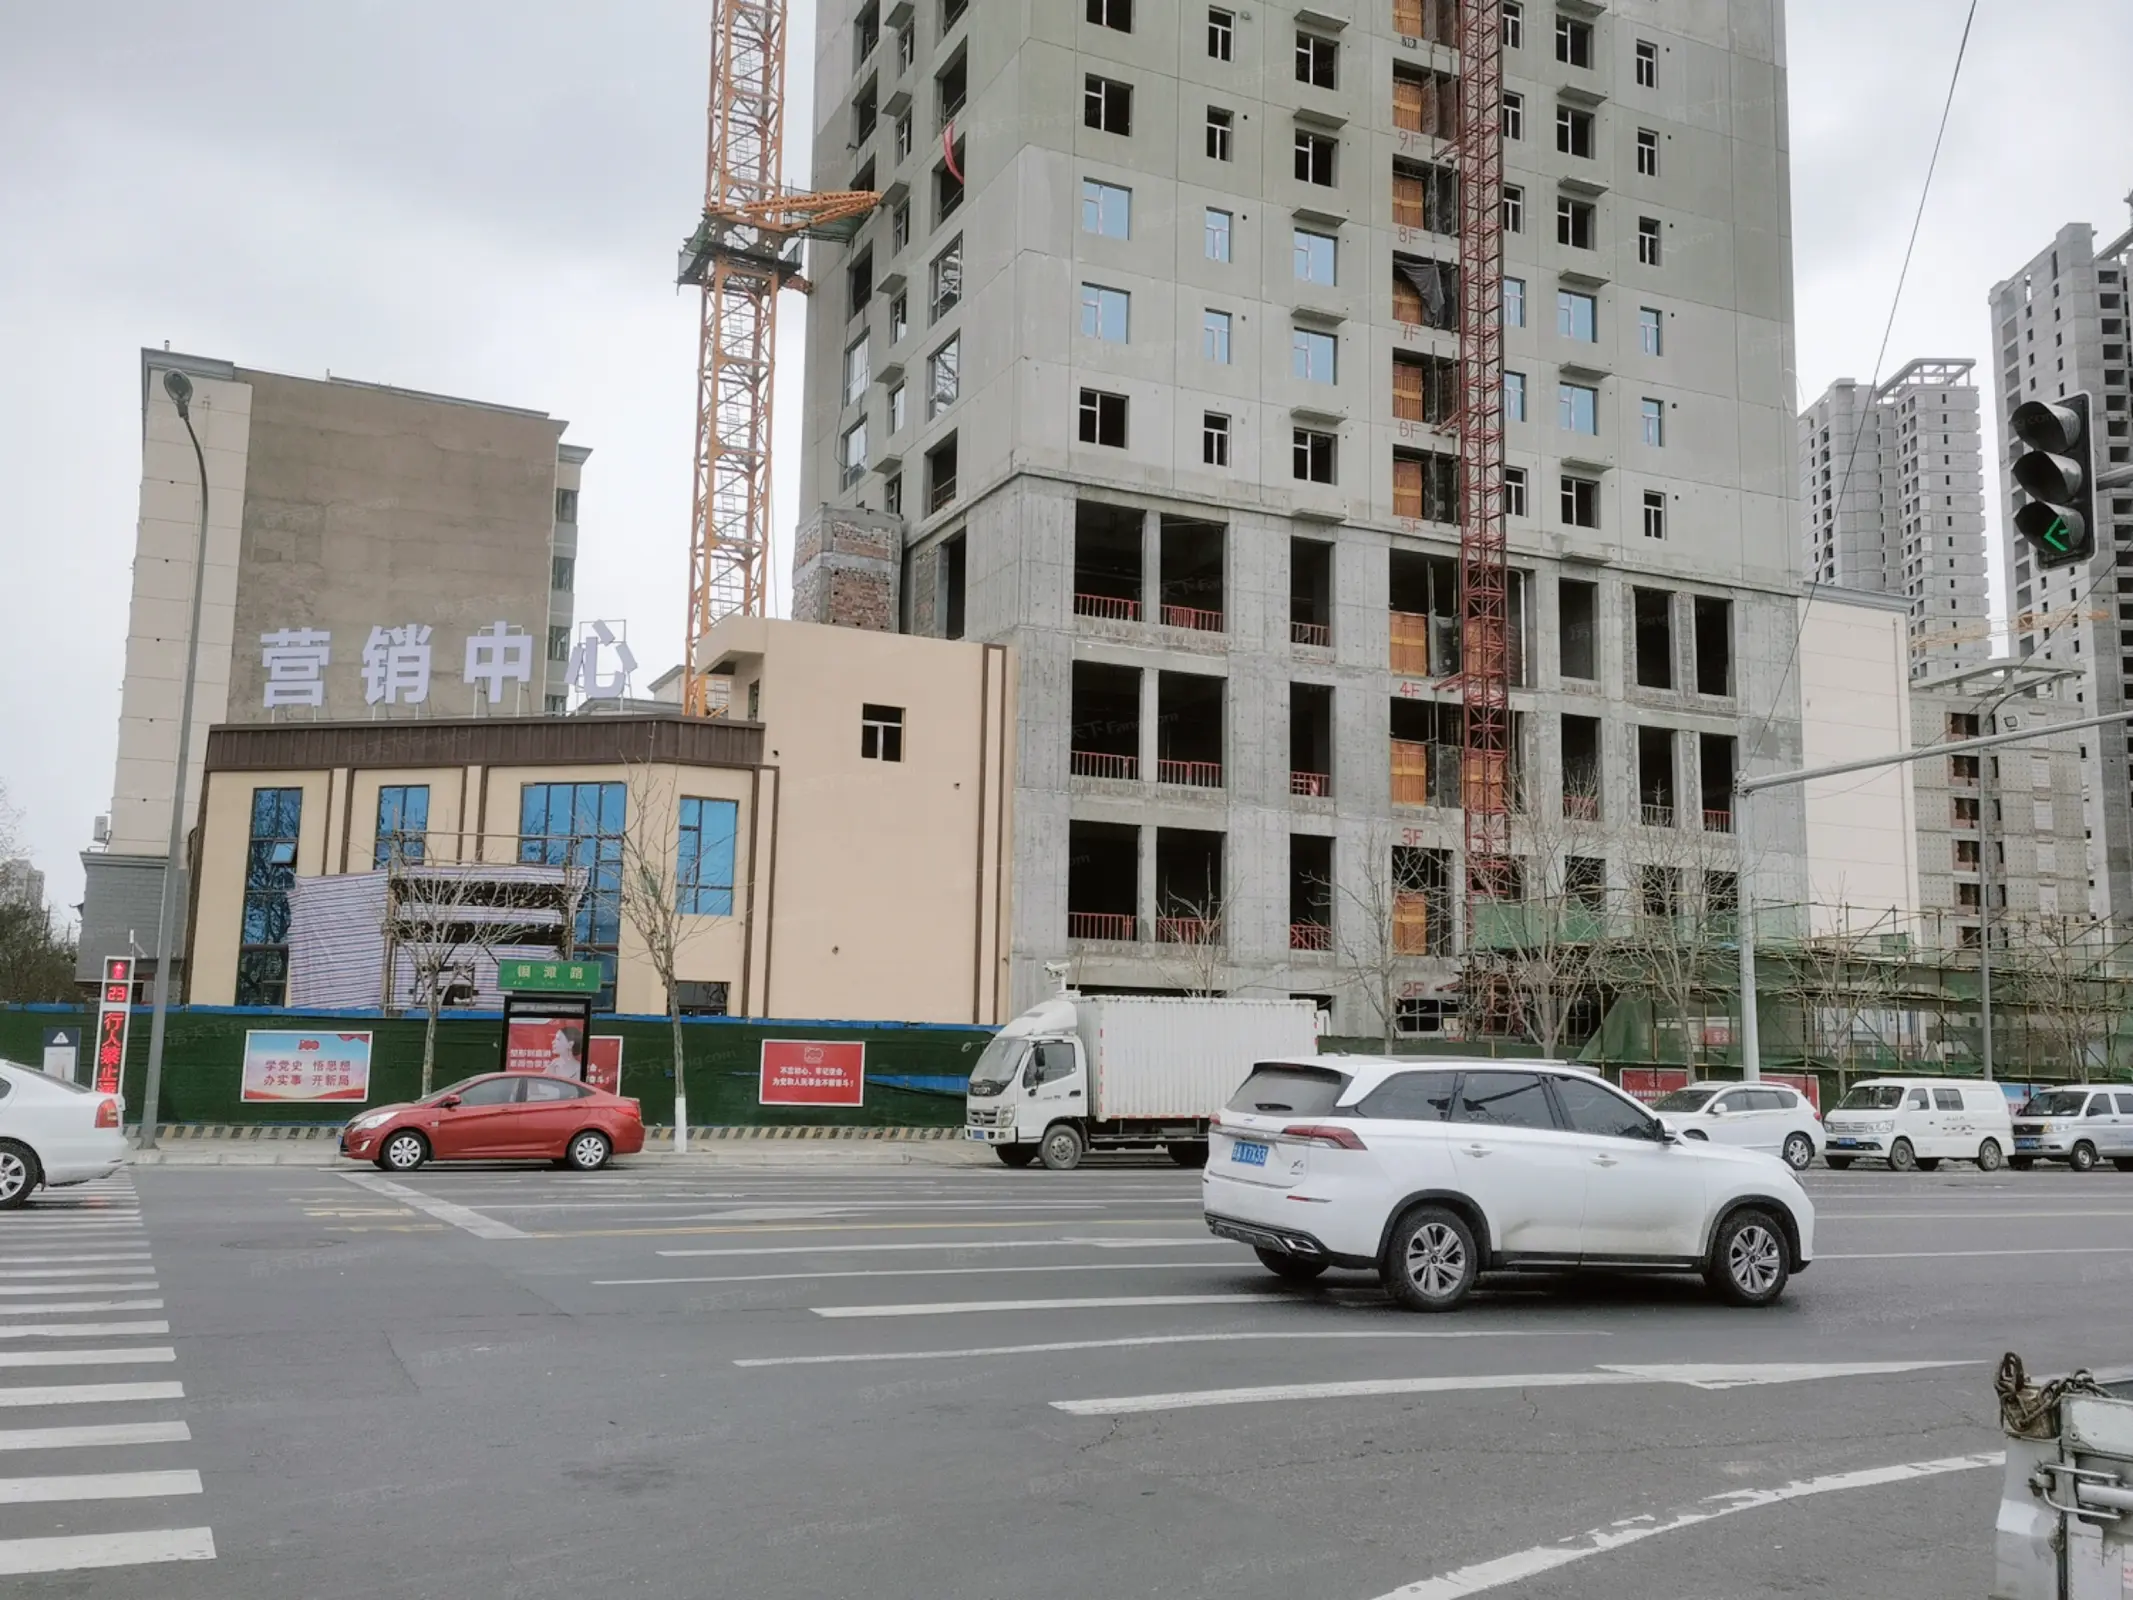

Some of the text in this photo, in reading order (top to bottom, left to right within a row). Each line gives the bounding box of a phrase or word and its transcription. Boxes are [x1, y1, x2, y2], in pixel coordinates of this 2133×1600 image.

[1398, 130, 1420, 153] 9F
[1397, 225, 1420, 245] 8F
[1400, 322, 1422, 341] 7F
[260, 619, 638, 708] 营销中心
[1399, 680, 1421, 697] 4F
[1401, 827, 1423, 846] 3F
[107, 986, 128, 1002] 23
[1402, 981, 1424, 998] 2F
[265, 1060, 351, 1072] 学党史 悟思想
[263, 1075, 350, 1086] 办实事 开新局
